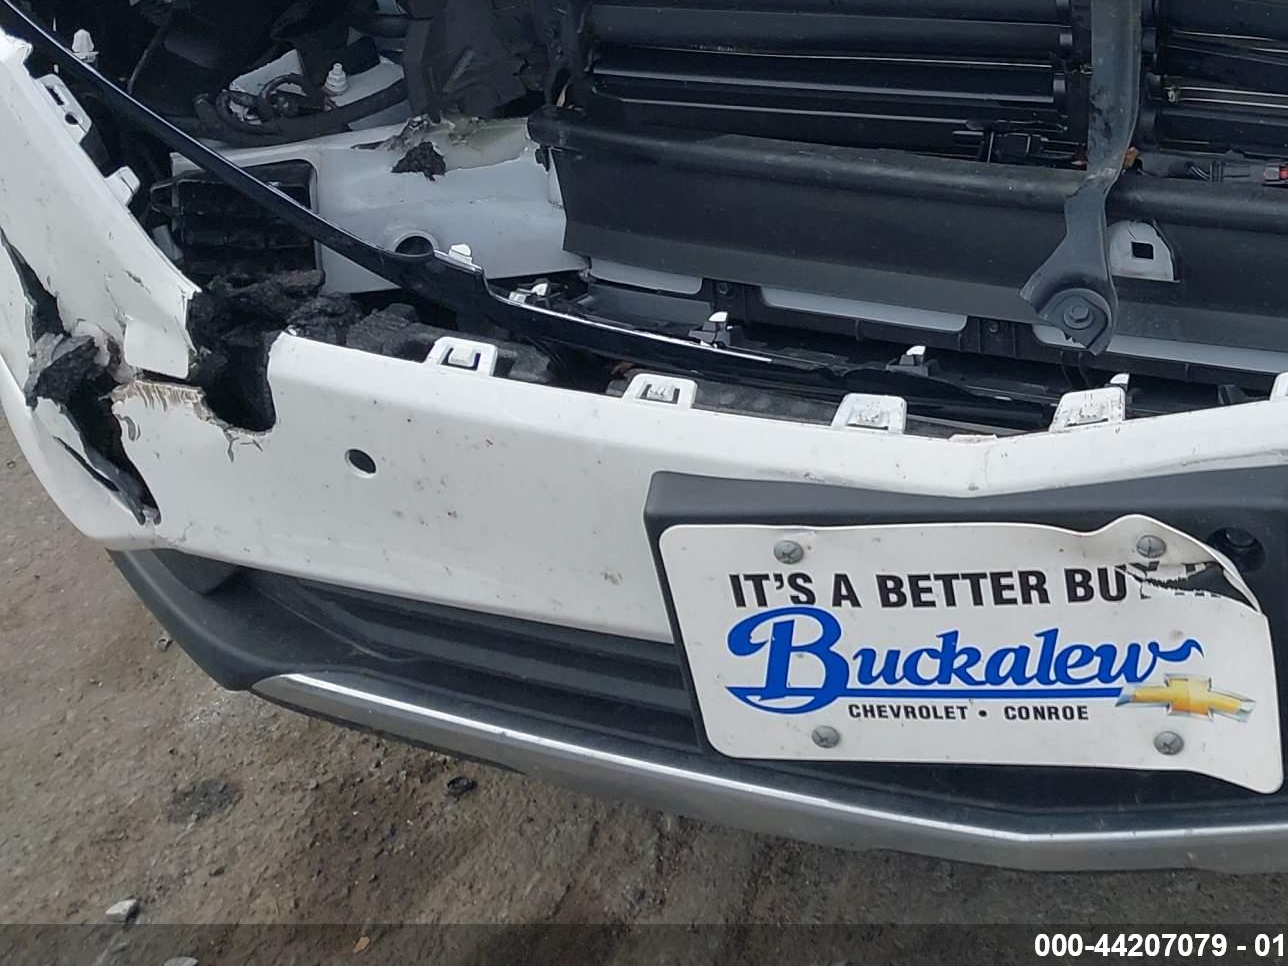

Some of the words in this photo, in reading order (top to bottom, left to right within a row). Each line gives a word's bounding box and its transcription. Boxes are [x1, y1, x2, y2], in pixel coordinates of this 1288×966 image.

[728, 572, 817, 608] IT'S
[831, 573, 863, 608] A
[875, 570, 1052, 608] BETTER
[727, 605, 1202, 714] Buckalew
[848, 703, 969, 720] CHEVROLET
[1003, 705, 1090, 721] CONROE
